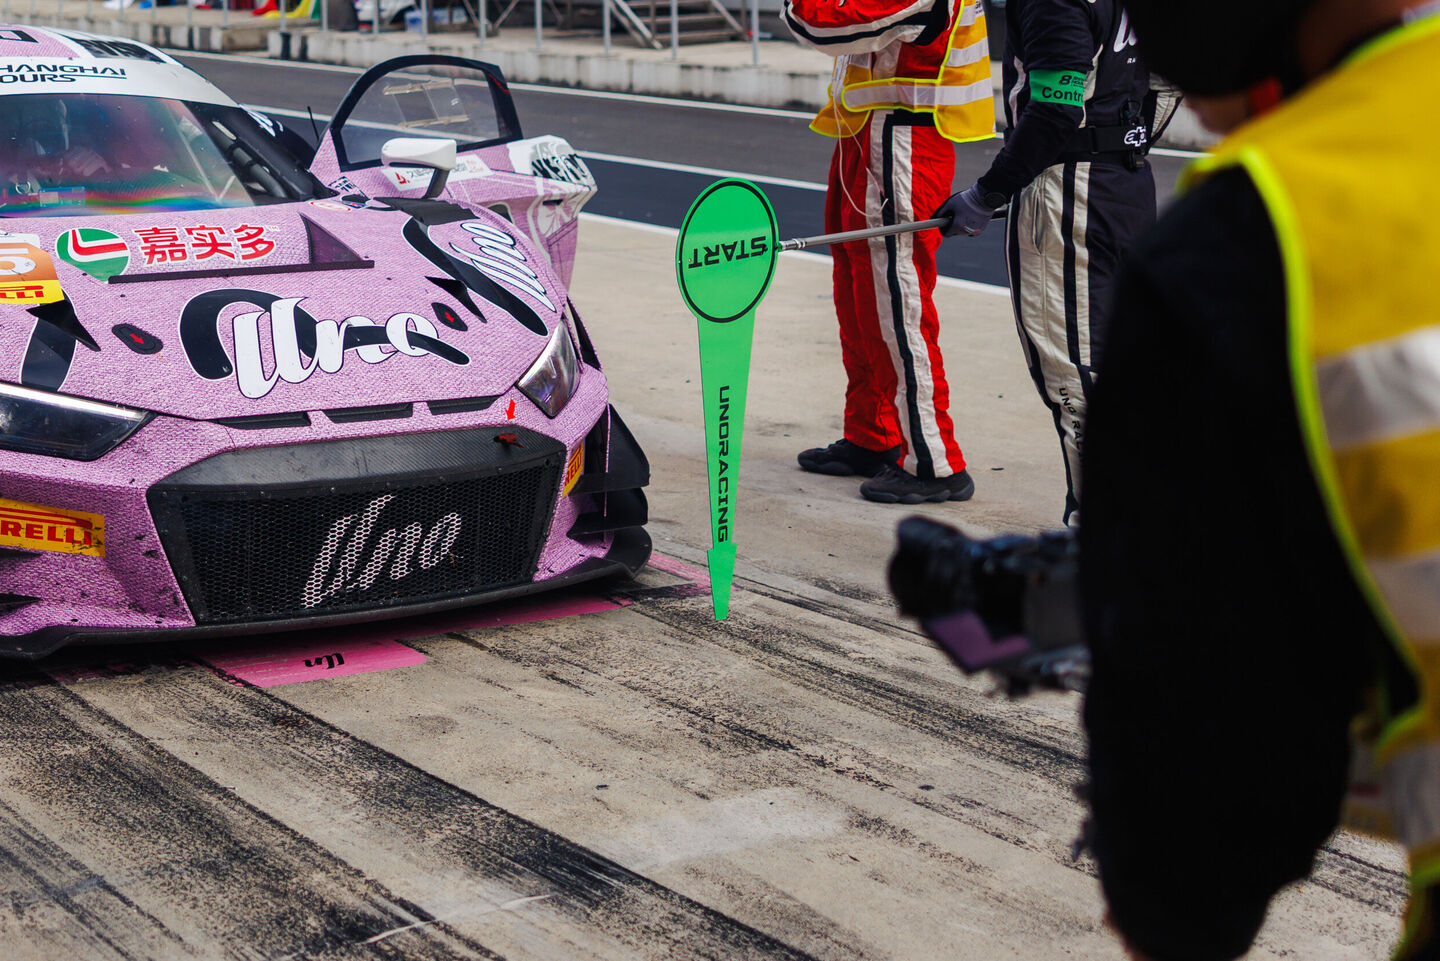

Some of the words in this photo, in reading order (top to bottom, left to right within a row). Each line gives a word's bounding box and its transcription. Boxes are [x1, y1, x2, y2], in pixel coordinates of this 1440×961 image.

[1059, 74, 1072, 86] 8
[134, 224, 276, 265] 嘉实多
[688, 234, 768, 270] START
[1059, 387, 1078, 415] UNO
